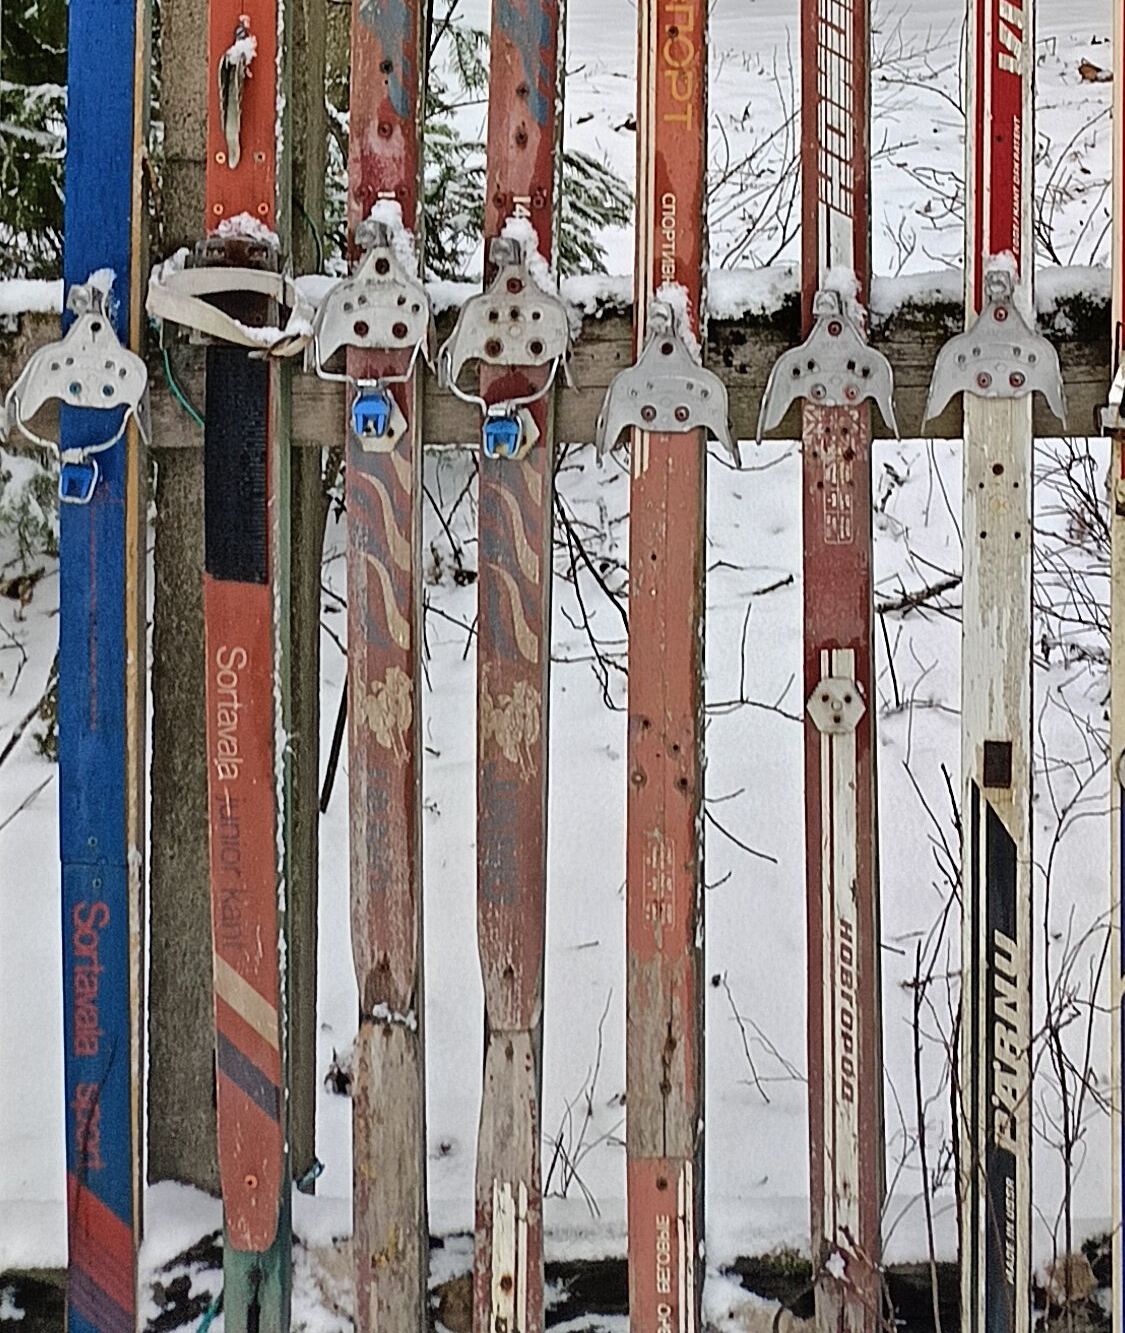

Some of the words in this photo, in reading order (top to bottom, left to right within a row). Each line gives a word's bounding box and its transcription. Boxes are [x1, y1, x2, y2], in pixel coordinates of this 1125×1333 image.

[215, 644, 248, 782] Sortavala
[217, 795, 247, 877] junior
[71, 900, 111, 1056] Sortavala
[836, 917, 857, 1104] НОВГОРОД
[1004, 1176, 1015, 1220] USSR
[656, 1214, 671, 1294] БЕГОВЫЕ
[1005, 1242, 1015, 1285] MADE
